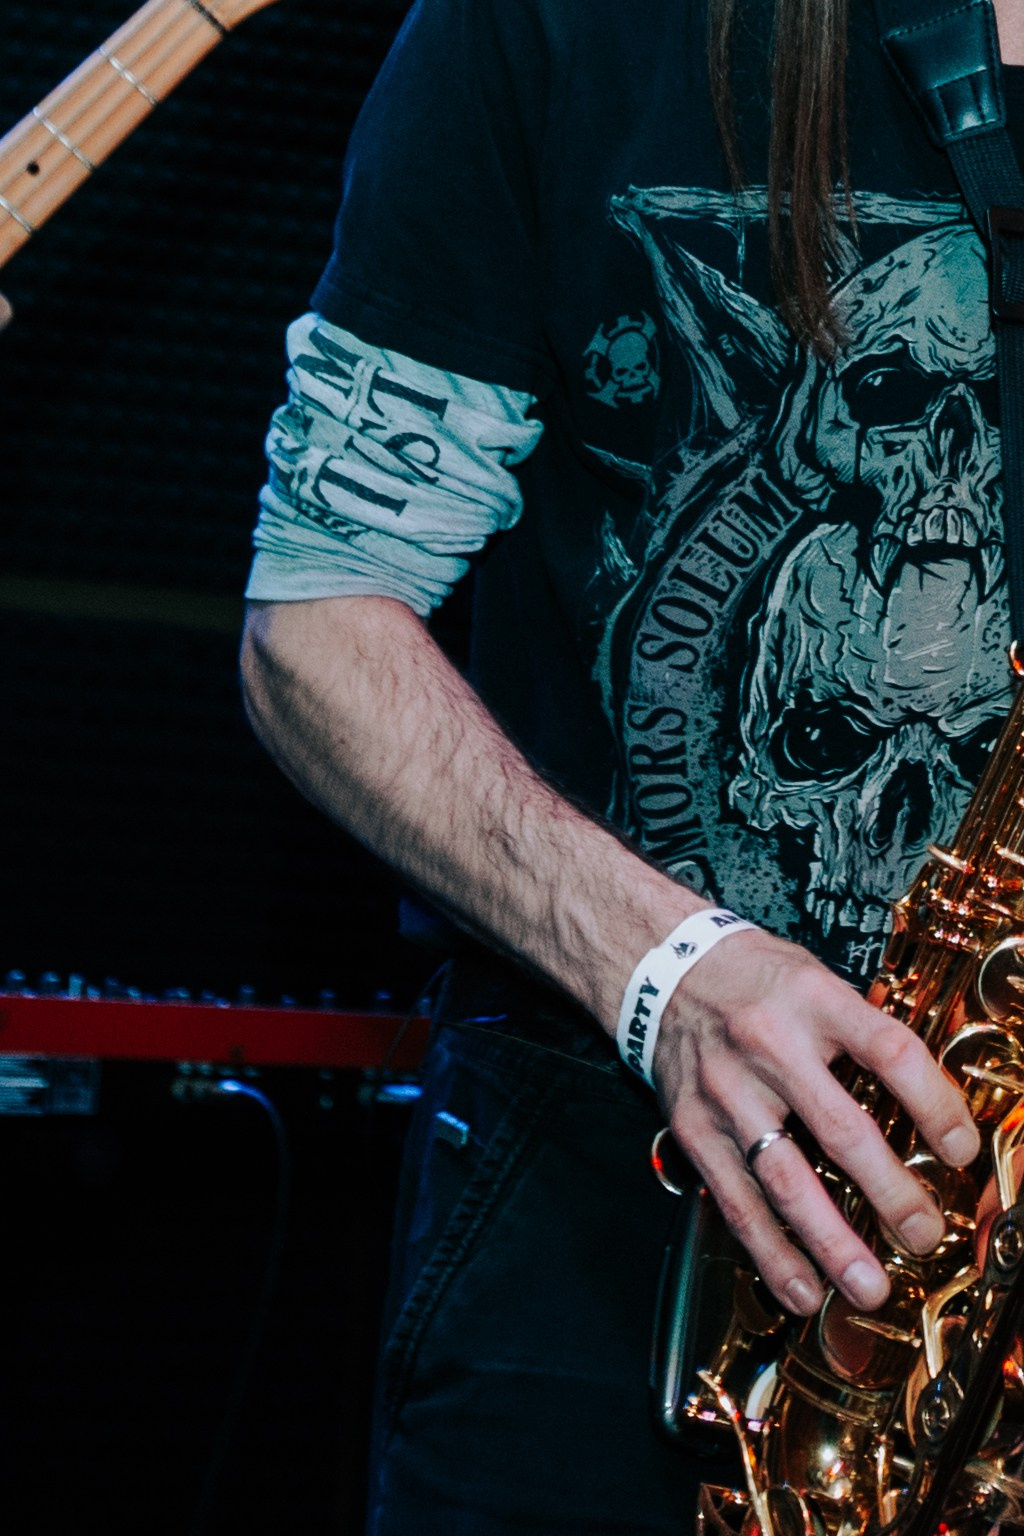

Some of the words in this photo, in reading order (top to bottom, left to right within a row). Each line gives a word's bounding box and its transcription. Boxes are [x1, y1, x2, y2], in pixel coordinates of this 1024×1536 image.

[637, 470, 799, 674] SOLUM
[627, 702, 708, 861] MORS
[626, 977, 660, 1075] PARTY
